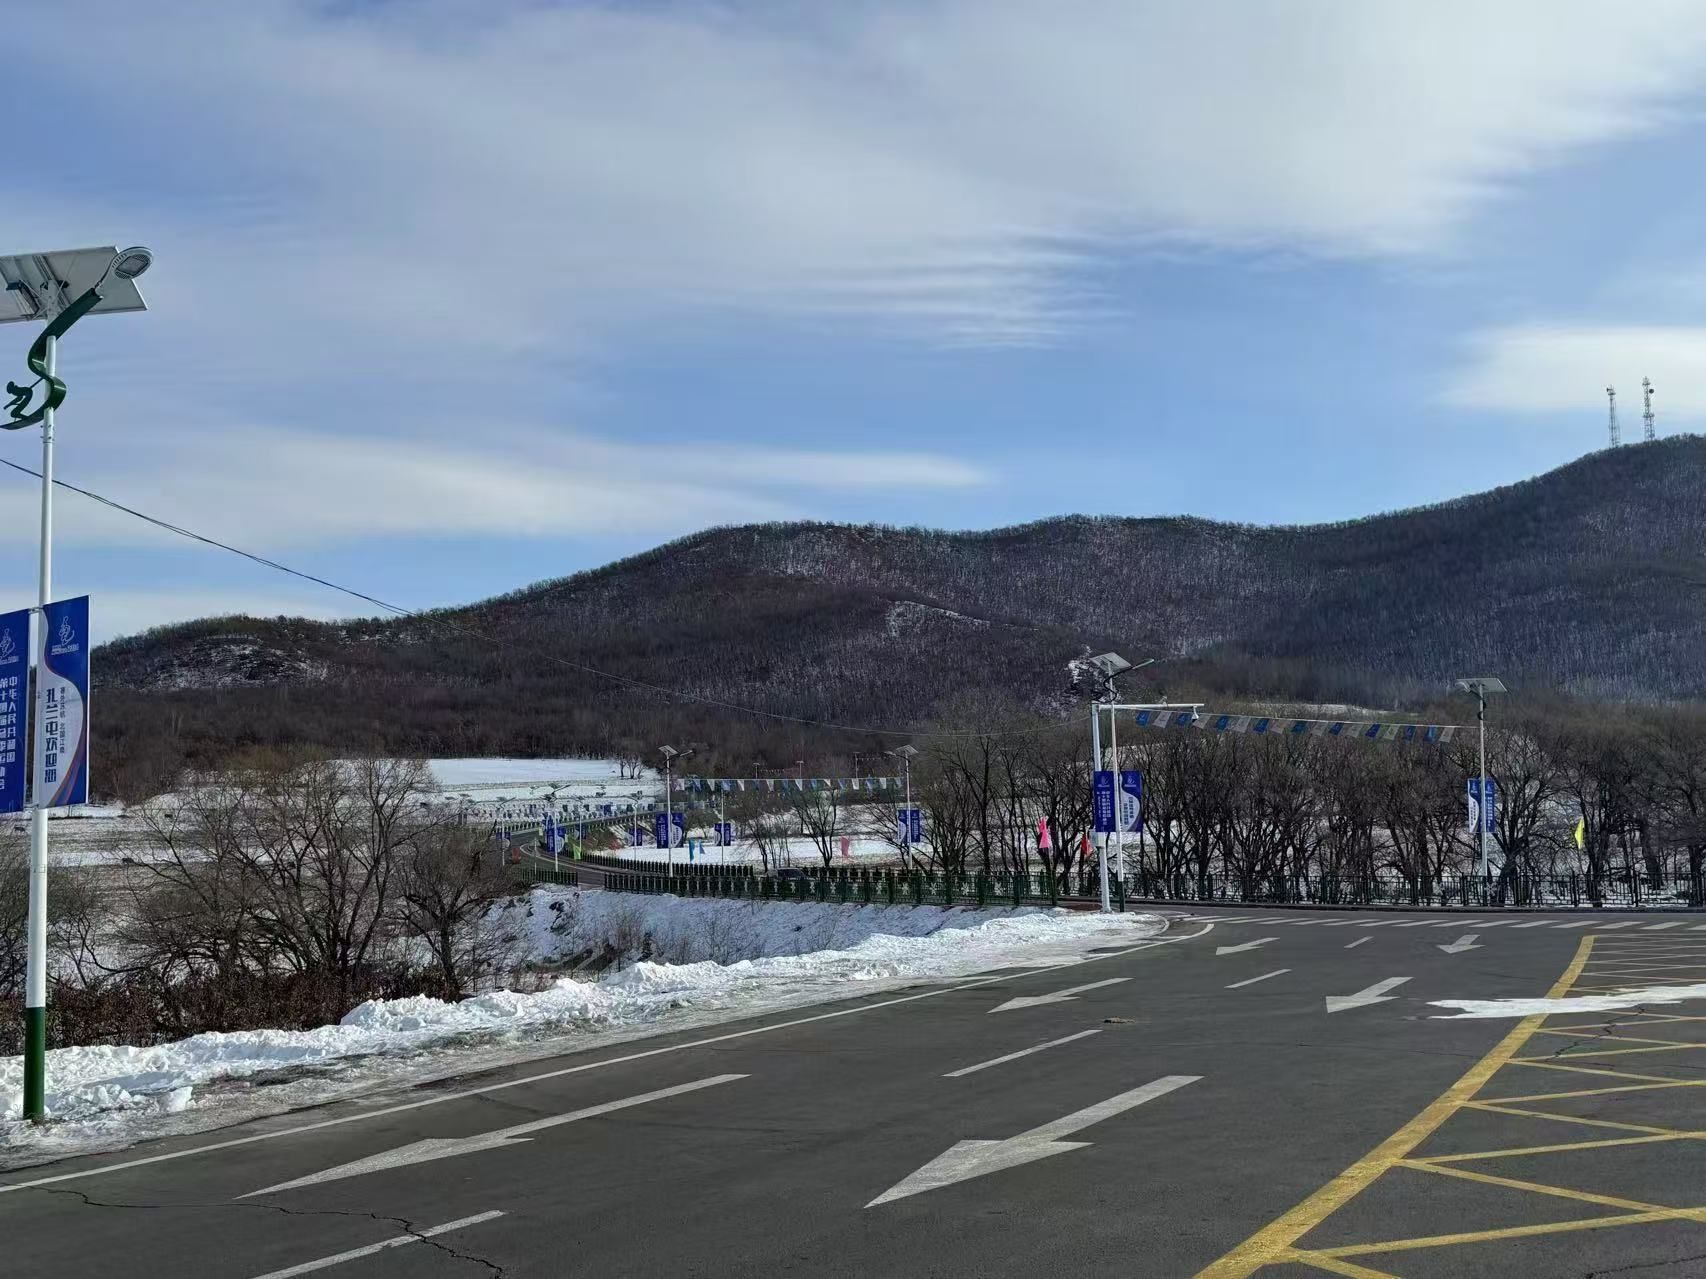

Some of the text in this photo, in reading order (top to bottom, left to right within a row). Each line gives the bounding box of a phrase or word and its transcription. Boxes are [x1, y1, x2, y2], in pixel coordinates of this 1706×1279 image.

[45, 687, 58, 784] 扎兰屯欢迎您
